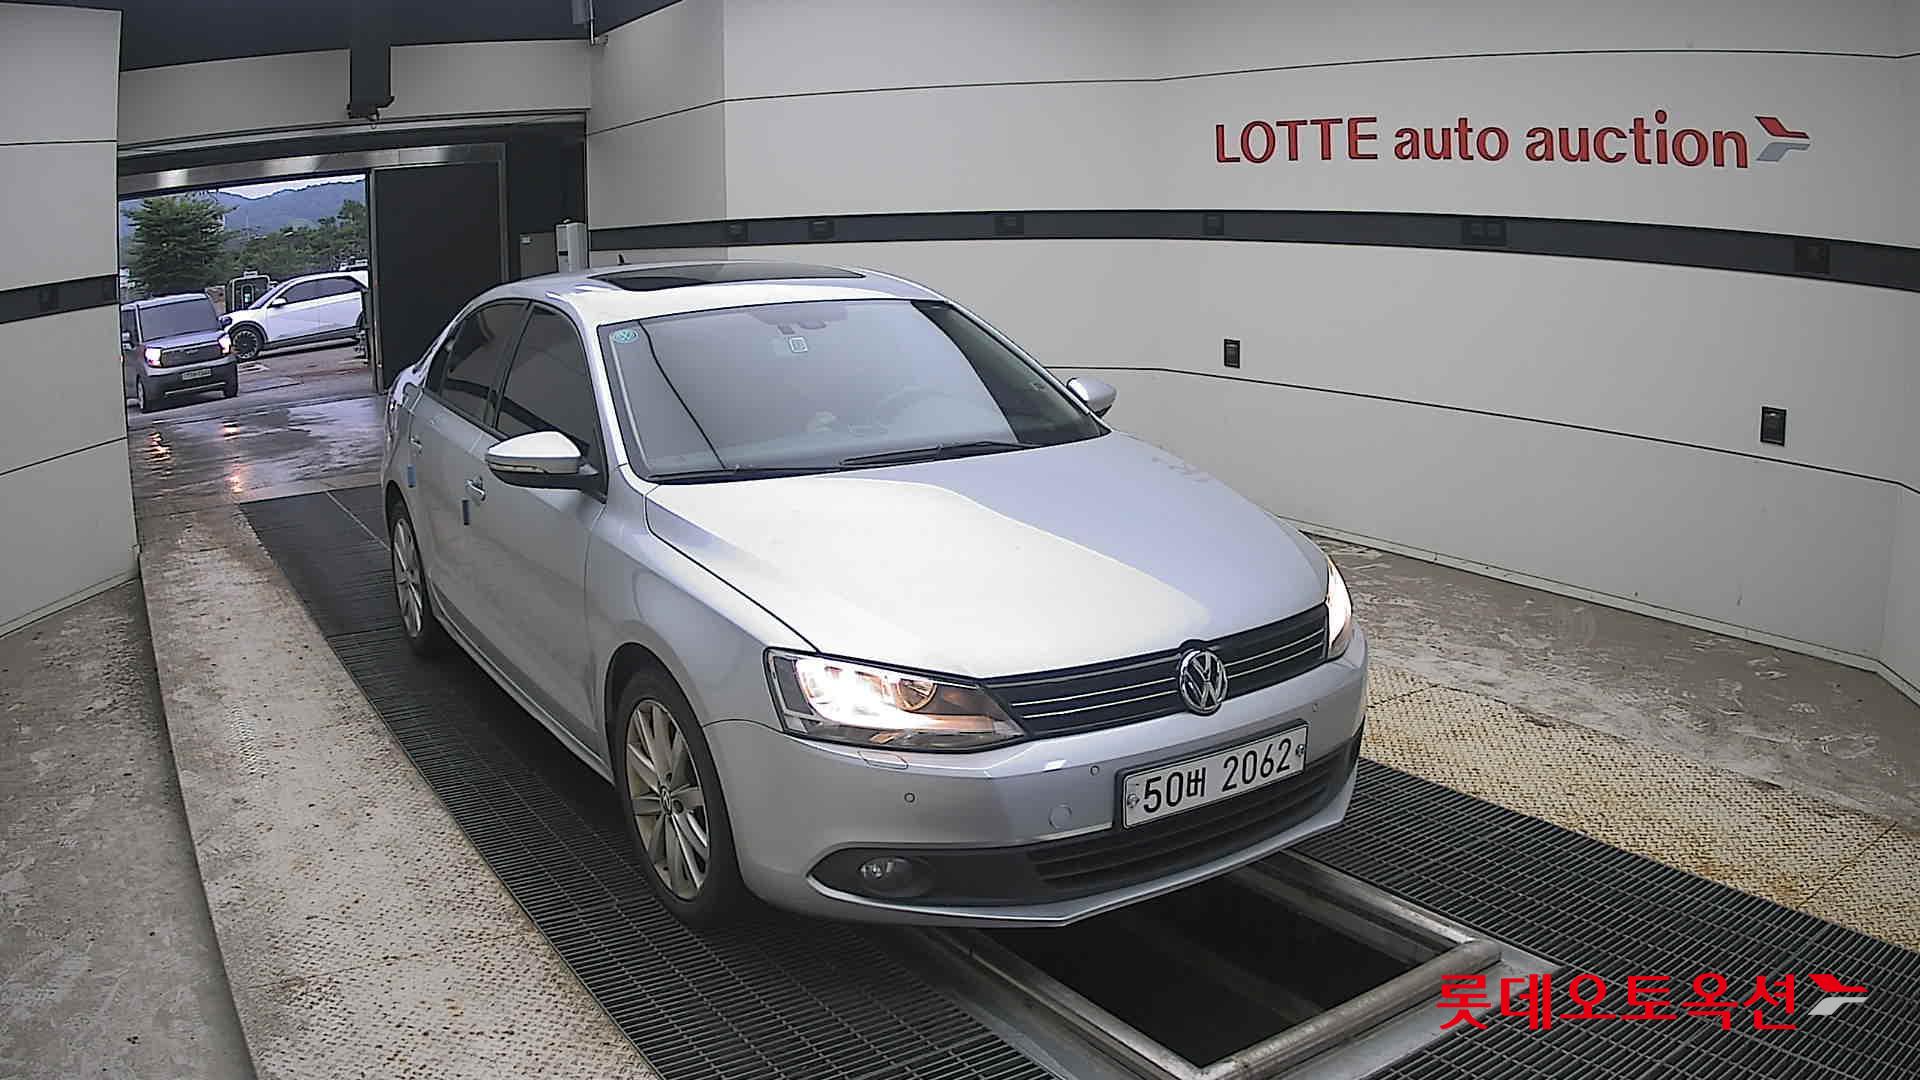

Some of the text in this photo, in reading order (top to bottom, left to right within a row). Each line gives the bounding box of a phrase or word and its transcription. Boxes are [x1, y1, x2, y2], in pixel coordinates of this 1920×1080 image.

[1216, 109, 1749, 168] LOTTE auto auction
[1143, 738, 1292, 813] 50버 2062
